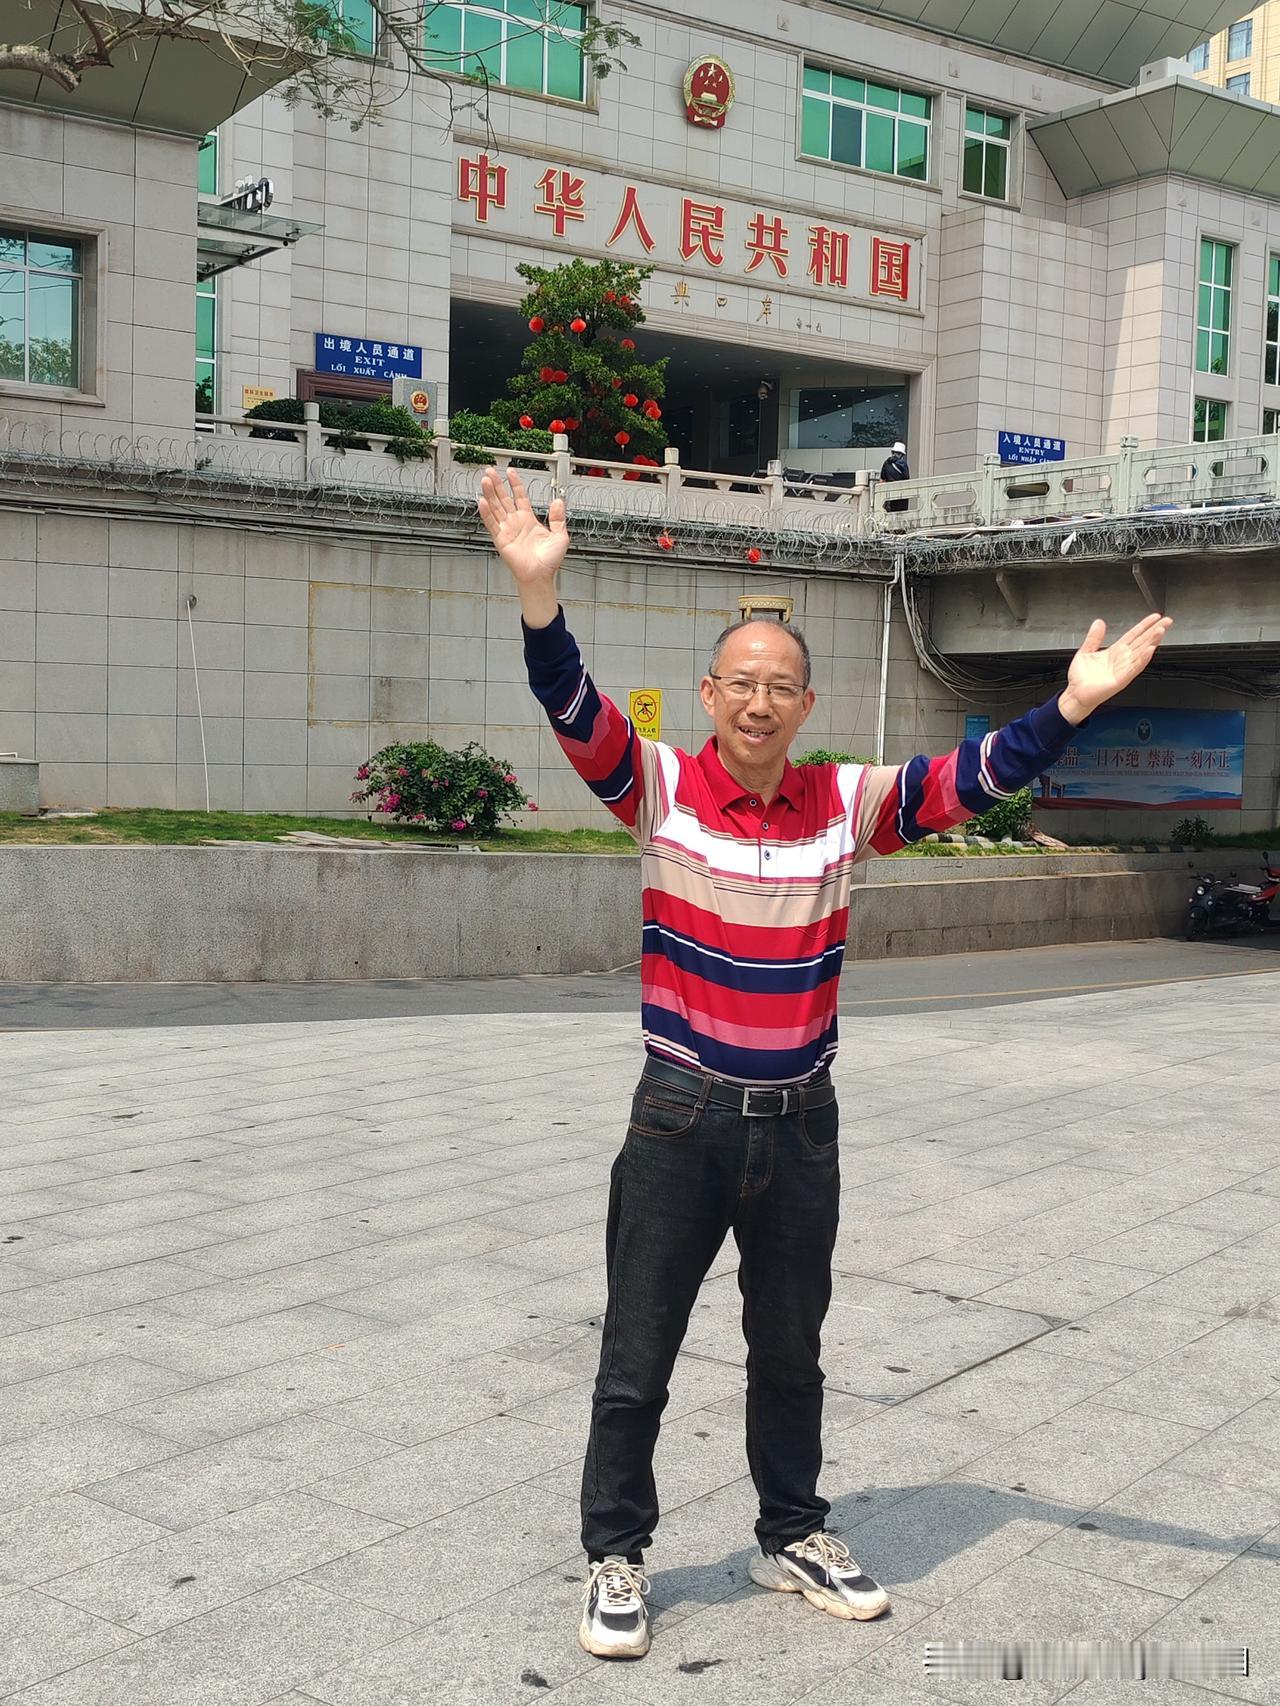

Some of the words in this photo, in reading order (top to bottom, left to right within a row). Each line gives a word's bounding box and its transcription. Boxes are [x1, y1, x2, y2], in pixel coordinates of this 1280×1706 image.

[458, 153, 911, 300] 中华人民共和国
[323, 337, 415, 361] 出境人员通道
[331, 362, 346, 372] LỐI
[353, 366, 376, 376] XUẤT
[355, 355, 385, 367] EXIT
[1003, 433, 1061, 451] 入境人员通道
[1018, 446, 1045, 457] ENTRY
